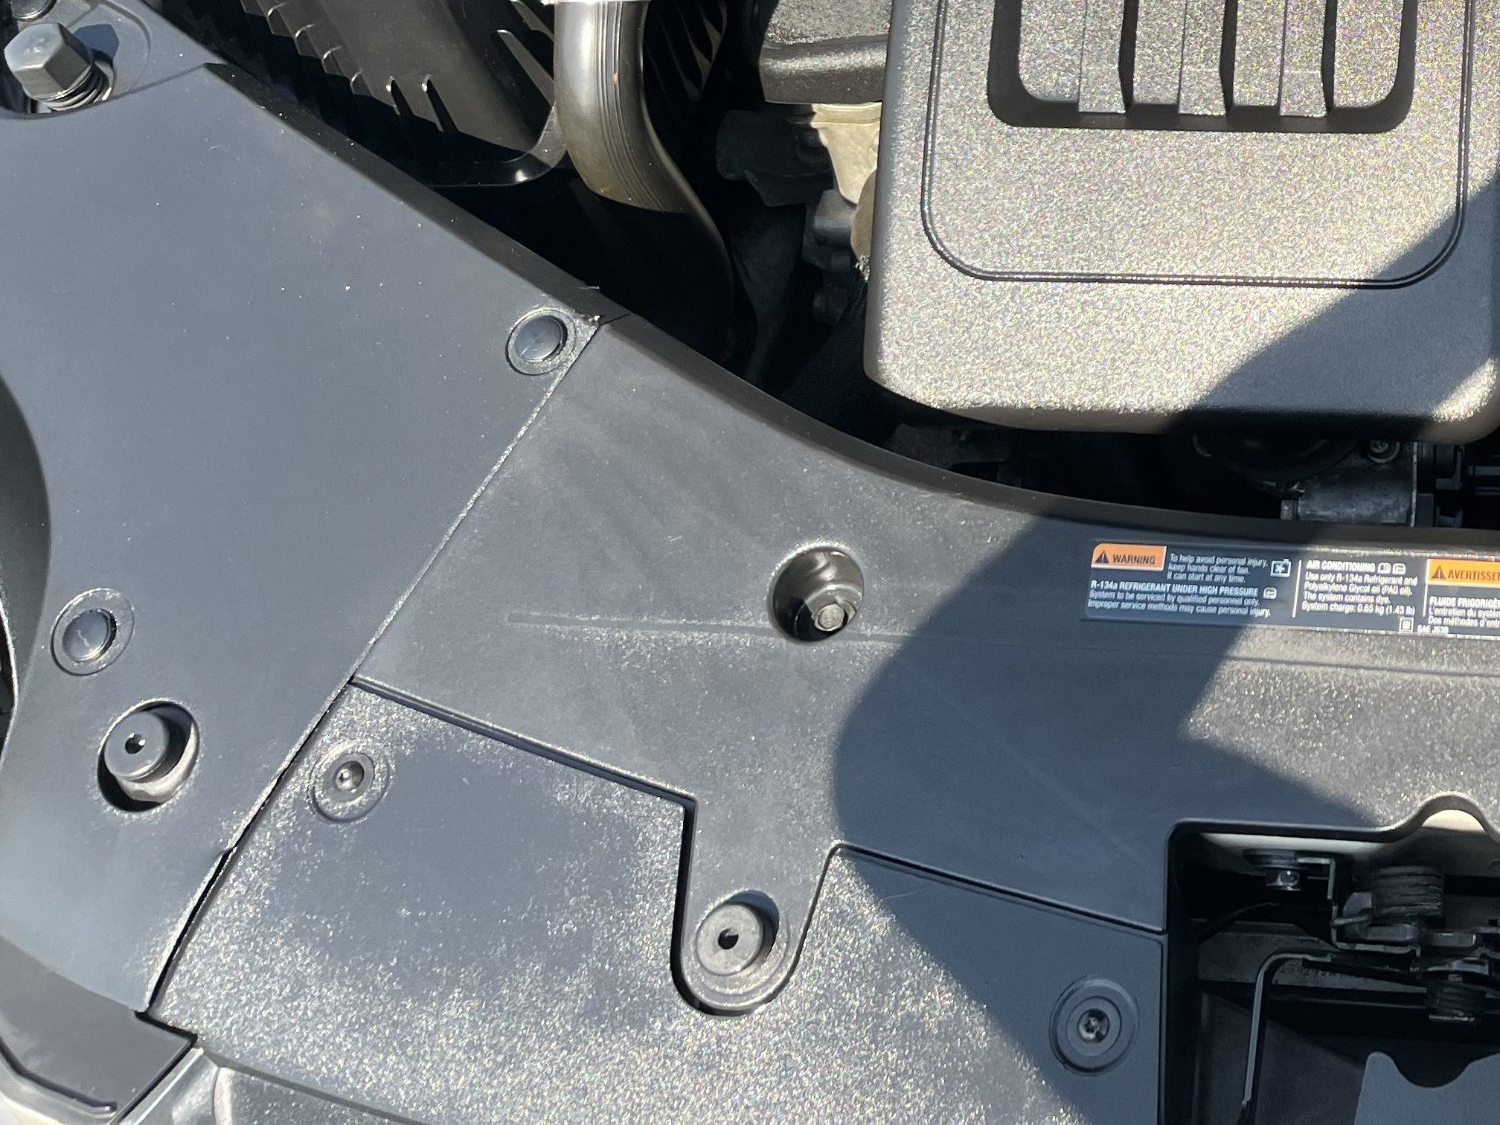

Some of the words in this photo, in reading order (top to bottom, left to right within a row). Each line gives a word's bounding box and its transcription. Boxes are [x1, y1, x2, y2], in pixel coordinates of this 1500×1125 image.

[1112, 555, 1156, 565] WARNING
[1170, 553, 1178, 561] To
[1179, 554, 1194, 563] help
[1196, 555, 1215, 564] avoid
[1216, 557, 1246, 565] personal
[1168, 563, 1185, 572] keep
[1187, 564, 1208, 572] hands
[1210, 565, 1227, 573] clear
[1228, 565, 1236, 573] of
[1306, 560, 1320, 569] AIR
[1321, 560, 1375, 572] CONDITIONING
[1188, 573, 1204, 581] start
[1214, 575, 1227, 583] any
[1306, 571, 1319, 581] Use
[1320, 573, 1336, 582] only
[1336, 573, 1363, 583] R-134a
[1364, 575, 1403, 585] Refrigerant
[1404, 577, 1418, 586] and
[1091, 580, 1118, 589] R-134a
[1119, 581, 1171, 592] REFRIGERANT
[1172, 584, 1198, 593] UNDER
[1199, 585, 1218, 594] HIGH
[1219, 586, 1258, 595] PRESSURE
[1348, 583, 1370, 594] Glycol
[1090, 590, 1116, 599] System
[1117, 591, 1124, 599] to
[1126, 591, 1135, 599] be
[1136, 593, 1165, 601] serviced
[1167, 594, 1176, 603] by
[1177, 595, 1207, 604] qualified
[1208, 597, 1243, 605] personnel
[1304, 591, 1317, 600] The
[1318, 592, 1343, 602] system
[1344, 593, 1374, 603] contains
[1429, 596, 1456, 606] FLUIDE
[1088, 599, 1119, 609] Improper
[1120, 601, 1146, 609] service
[1147, 603, 1178, 611] methods
[1179, 605, 1194, 613] may
[1218, 606, 1248, 615] personal
[1250, 607, 1271, 618] injury.
[1302, 601, 1328, 612] System
[1329, 603, 1356, 614] charge:
[1375, 605, 1385, 615] kg
[1429, 606, 1466, 617] L'entretien
[1467, 608, 1476, 617] du
[1428, 615, 1442, 625] Des
